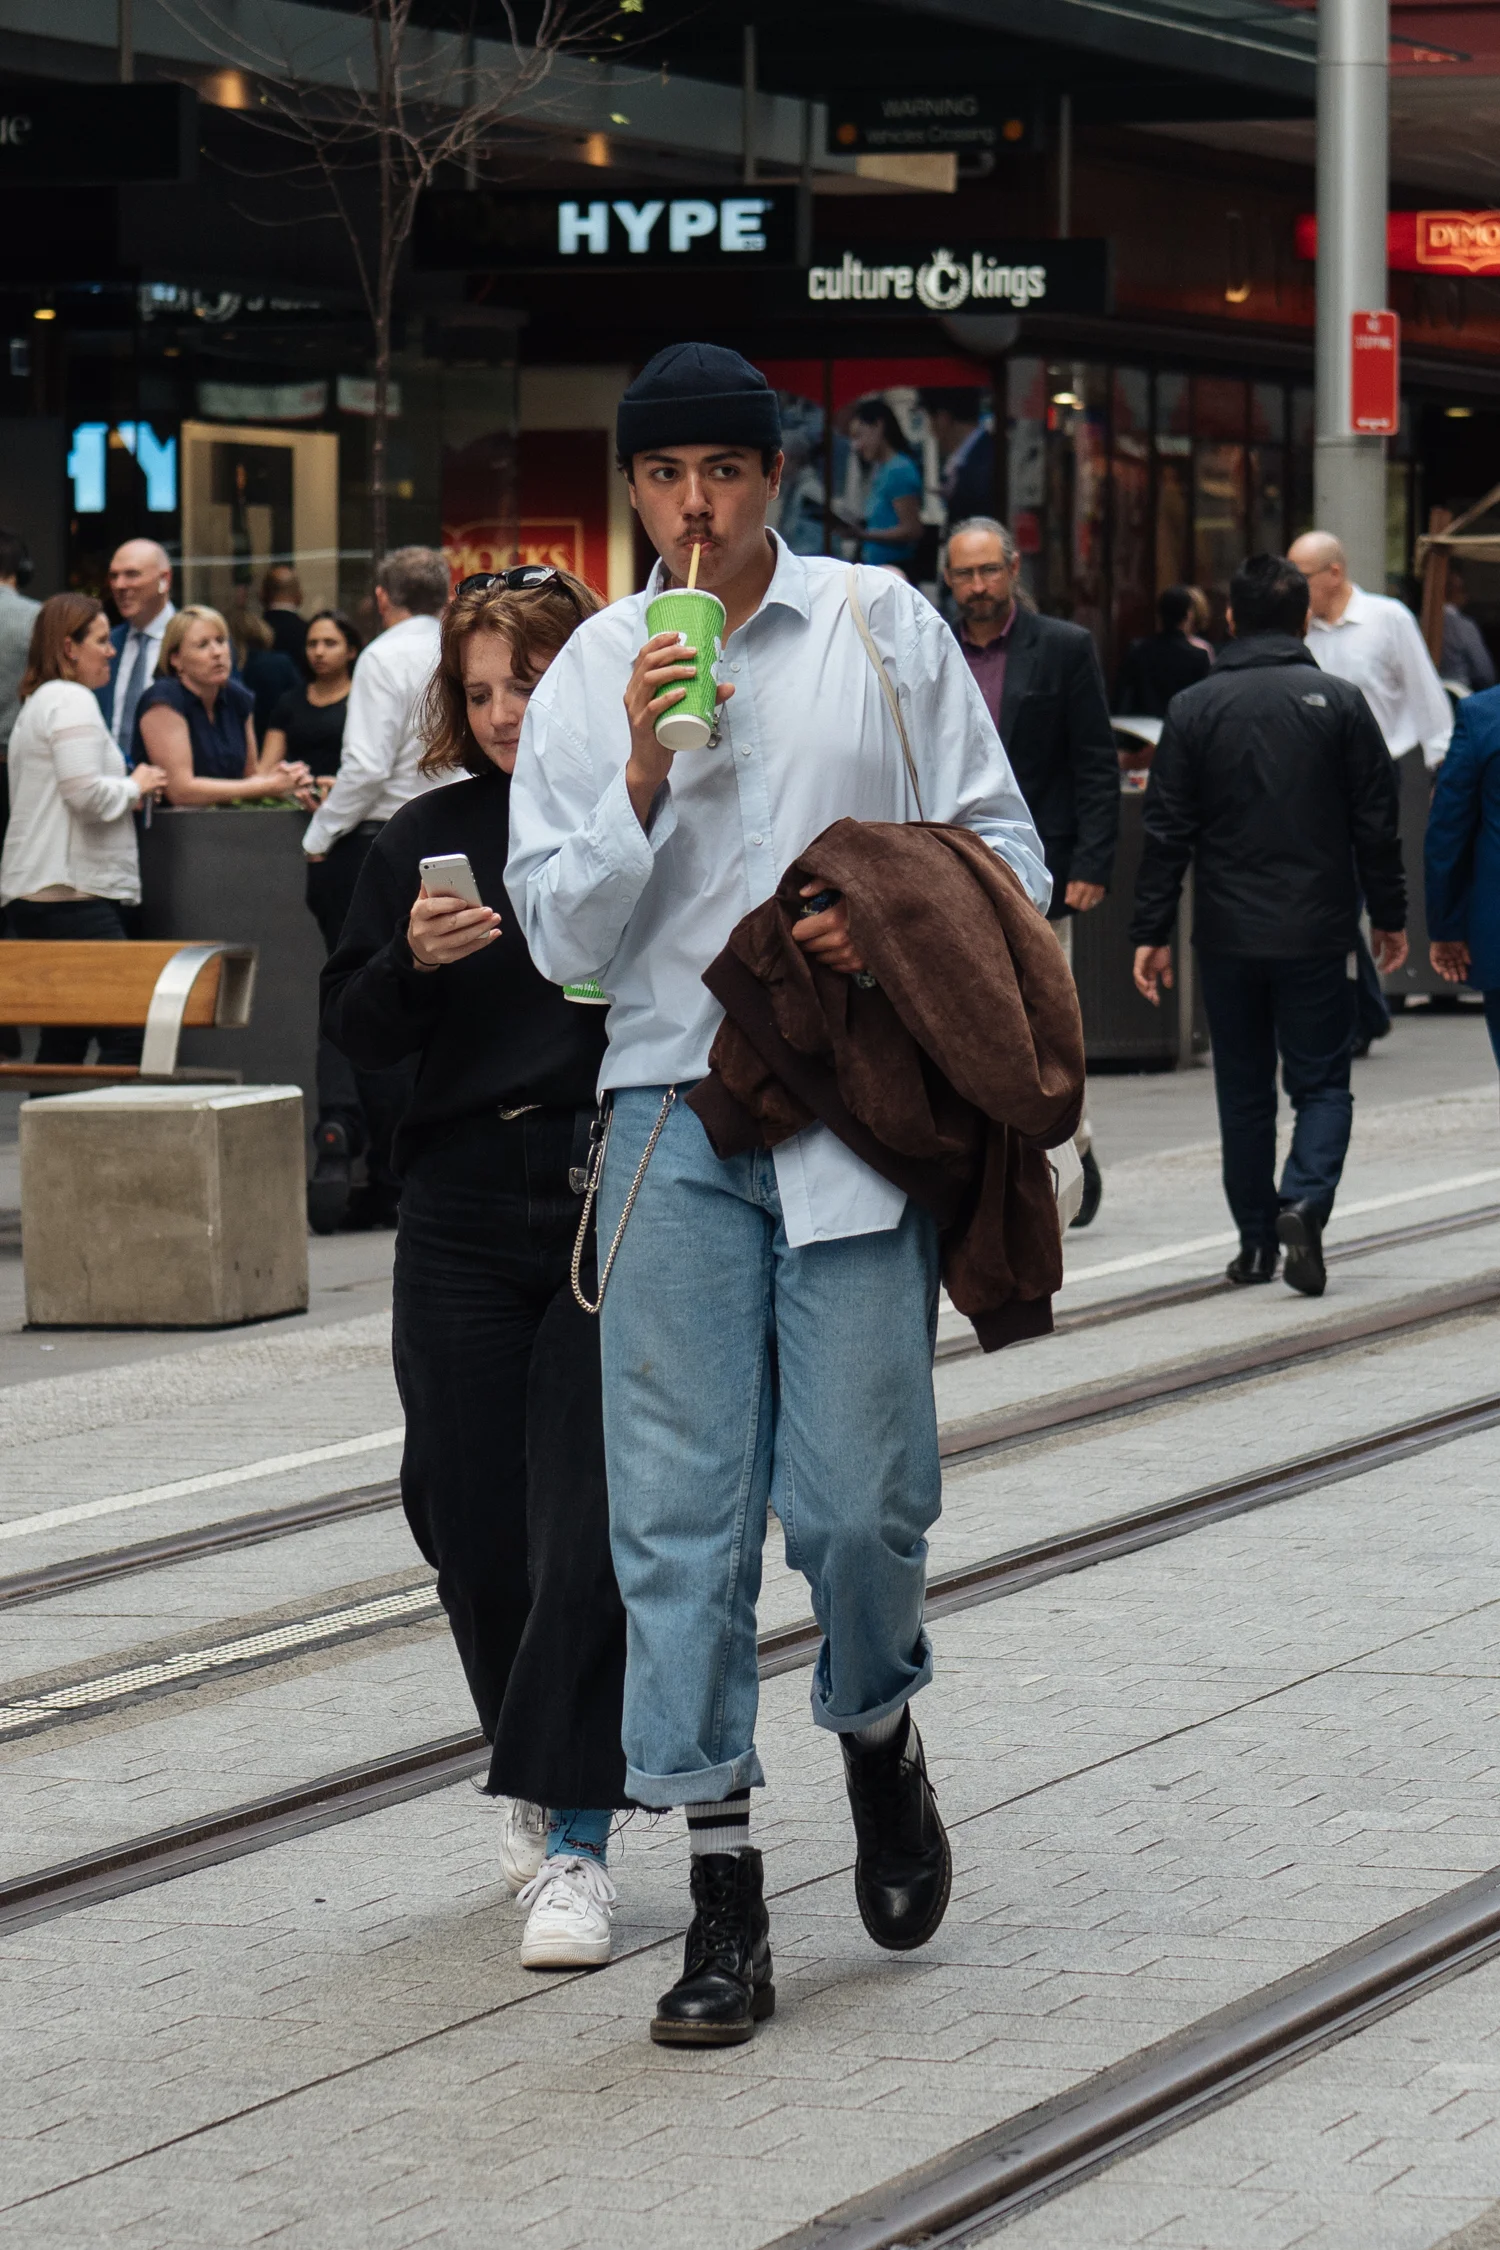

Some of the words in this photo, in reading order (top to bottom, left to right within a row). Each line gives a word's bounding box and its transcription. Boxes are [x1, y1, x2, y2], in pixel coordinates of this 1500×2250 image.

[881, 96, 980, 118] WARNING
[558, 199, 767, 254] HYPE
[808, 250, 914, 300] culture
[972, 250, 1047, 308] kings
